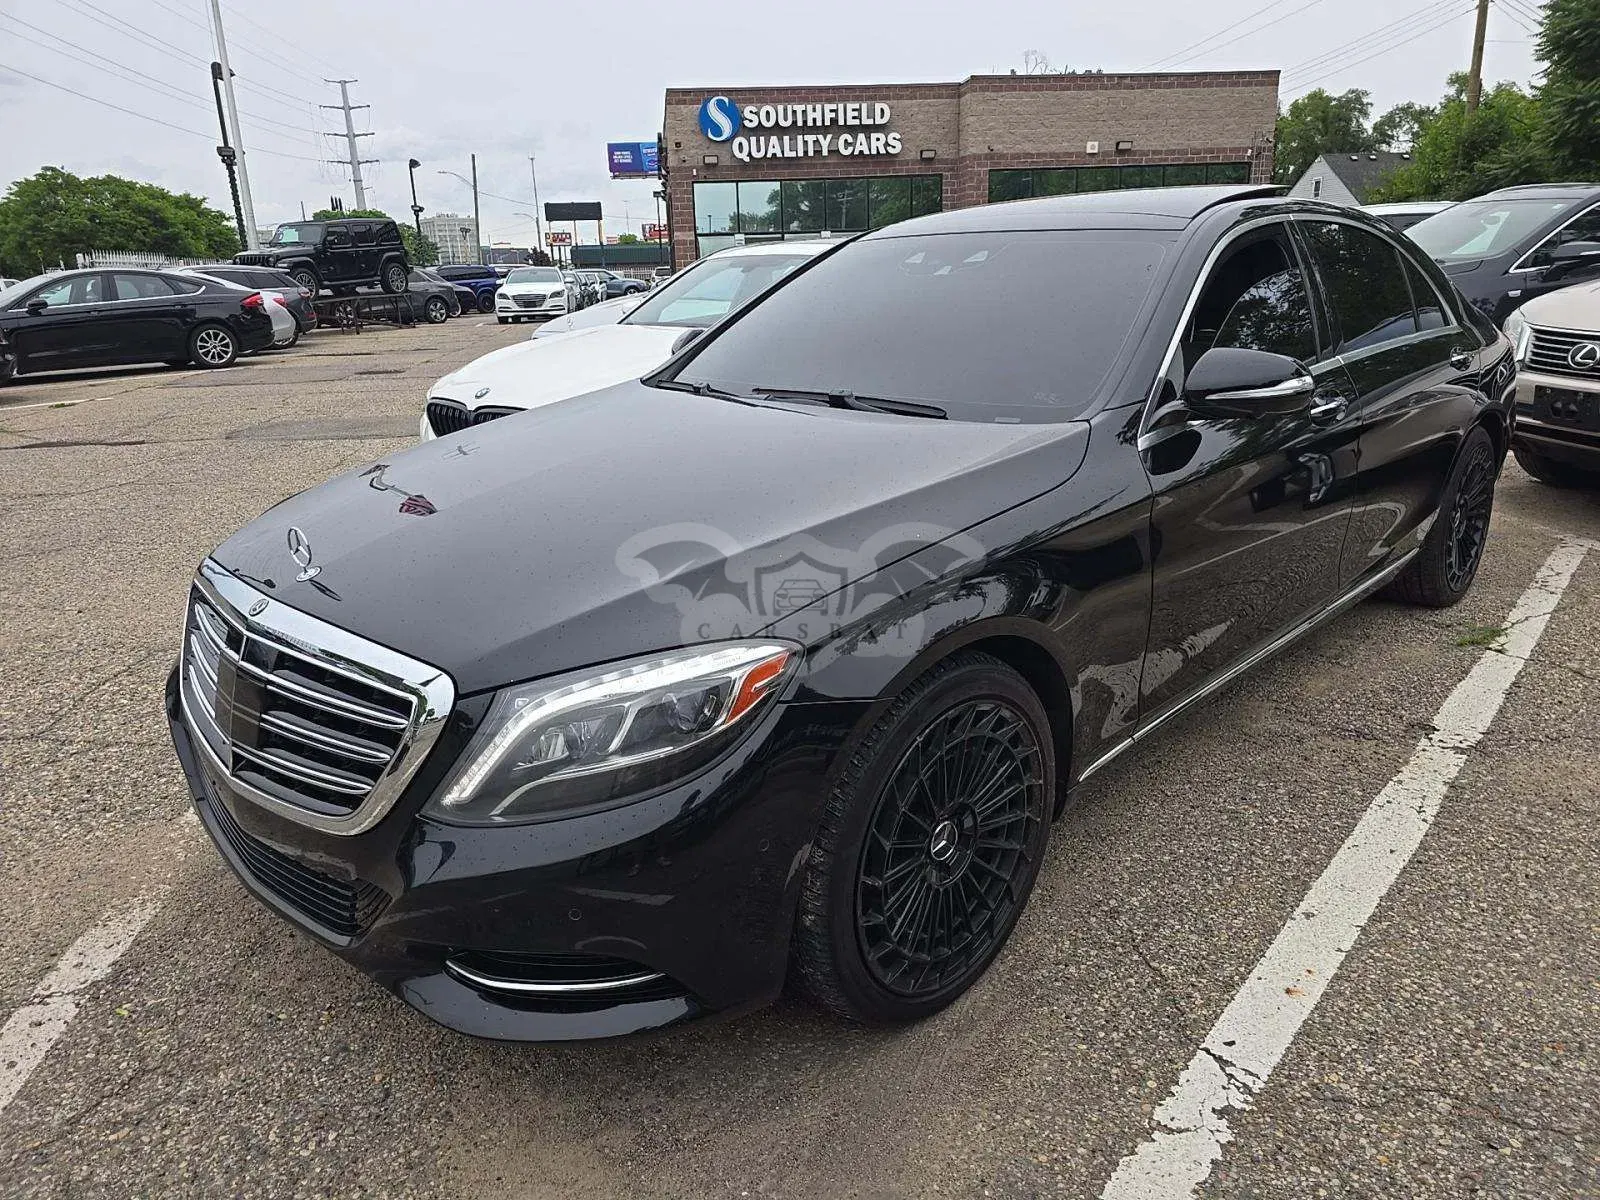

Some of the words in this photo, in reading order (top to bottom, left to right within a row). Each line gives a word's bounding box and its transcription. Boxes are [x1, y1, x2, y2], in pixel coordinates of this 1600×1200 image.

[707, 96, 733, 142] S
[743, 102, 891, 128] SOUTHFIELD
[732, 133, 833, 162] QUALITY
[838, 132, 902, 156] CARS
